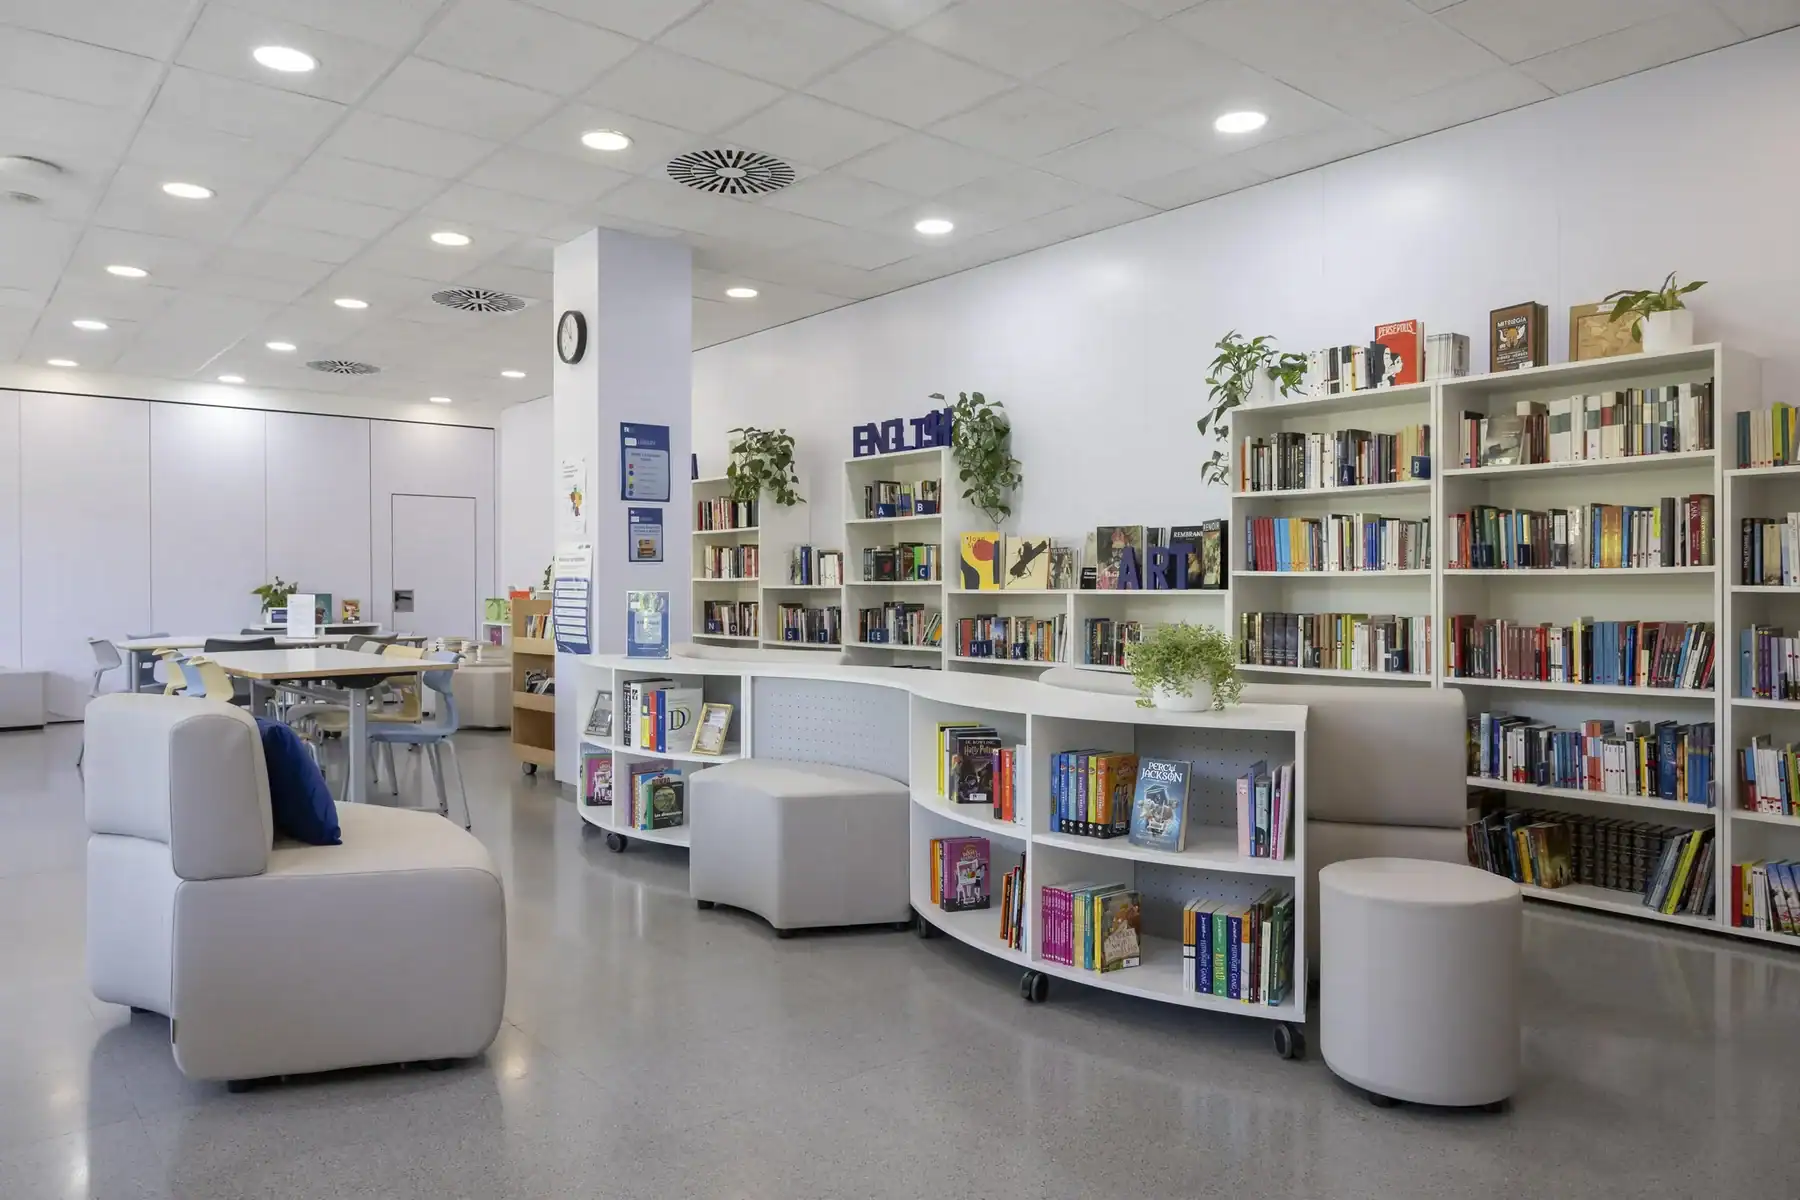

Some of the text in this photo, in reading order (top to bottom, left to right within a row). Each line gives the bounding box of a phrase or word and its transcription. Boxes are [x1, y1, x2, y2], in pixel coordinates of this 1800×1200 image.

[853, 408, 952, 457] ENGLISH
[1414, 461, 1420, 474] B
[1342, 470, 1348, 482] A
[878, 506, 885, 516] A
[917, 503, 923, 512] B
[1117, 542, 1196, 590] ART
[920, 568, 925, 577] C
[708, 622, 715, 630] N
[787, 631, 793, 639] S
[819, 632, 825, 640] T
[971, 643, 977, 653] H
[1015, 646, 1021, 656] K
[1393, 656, 1399, 668] D
[1148, 761, 1176, 772] PERCY
[1141, 768, 1182, 784] JACKSON
